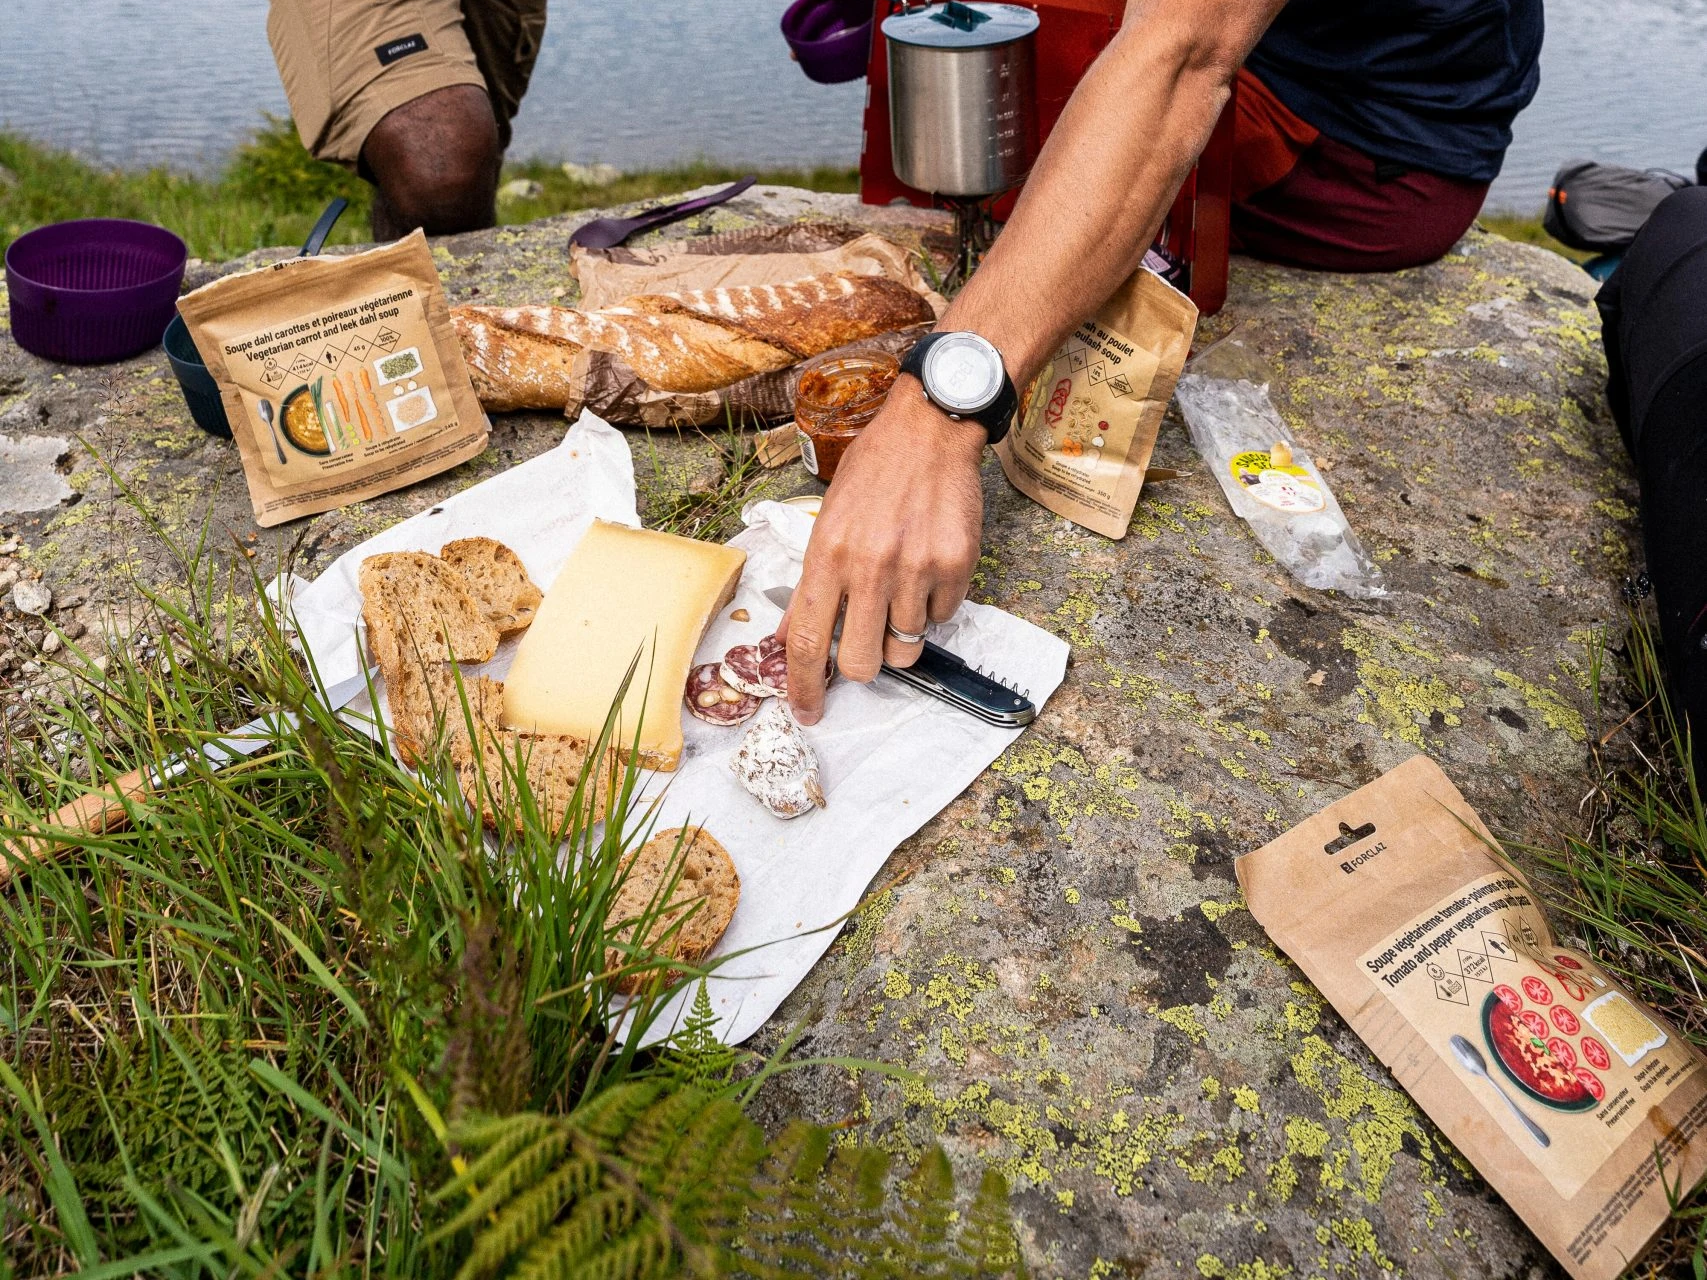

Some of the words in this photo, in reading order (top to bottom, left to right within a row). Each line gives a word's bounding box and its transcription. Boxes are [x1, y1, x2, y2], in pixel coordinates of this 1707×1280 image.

[225, 341, 253, 355] Soupe
[254, 332, 274, 346] dahl
[275, 322, 310, 340] carottes
[311, 318, 320, 328] et
[322, 307, 358, 327] poireaux
[359, 289, 413, 312] végétarienne
[246, 341, 294, 362] Vegetarian
[295, 330, 321, 347] carrot
[323, 324, 339, 338] and
[340, 319, 358, 332] leek
[359, 312, 378, 326] dahl
[379, 307, 399, 320] soup
[380, 334, 394, 343] 100%
[1073, 330, 1102, 352] oulash
[1101, 347, 1122, 365] soup
[1097, 329, 1109, 341] au
[1106, 337, 1134, 357] poulet
[1351, 842, 1387, 868] FORCLAZ
[1366, 948, 1398, 974] Soupe
[1392, 915, 1445, 952] végétarienne
[1437, 882, 1500, 918] tomates-poivrons
[1381, 958, 1417, 988] Tomato
[1414, 944, 1433, 963] and
[1428, 928, 1458, 955] pepper
[1453, 905, 1494, 932] vegetarian
[1489, 898, 1510, 910] soup
[1464, 963, 1477, 975] 372
[1473, 955, 1486, 967] kcal
